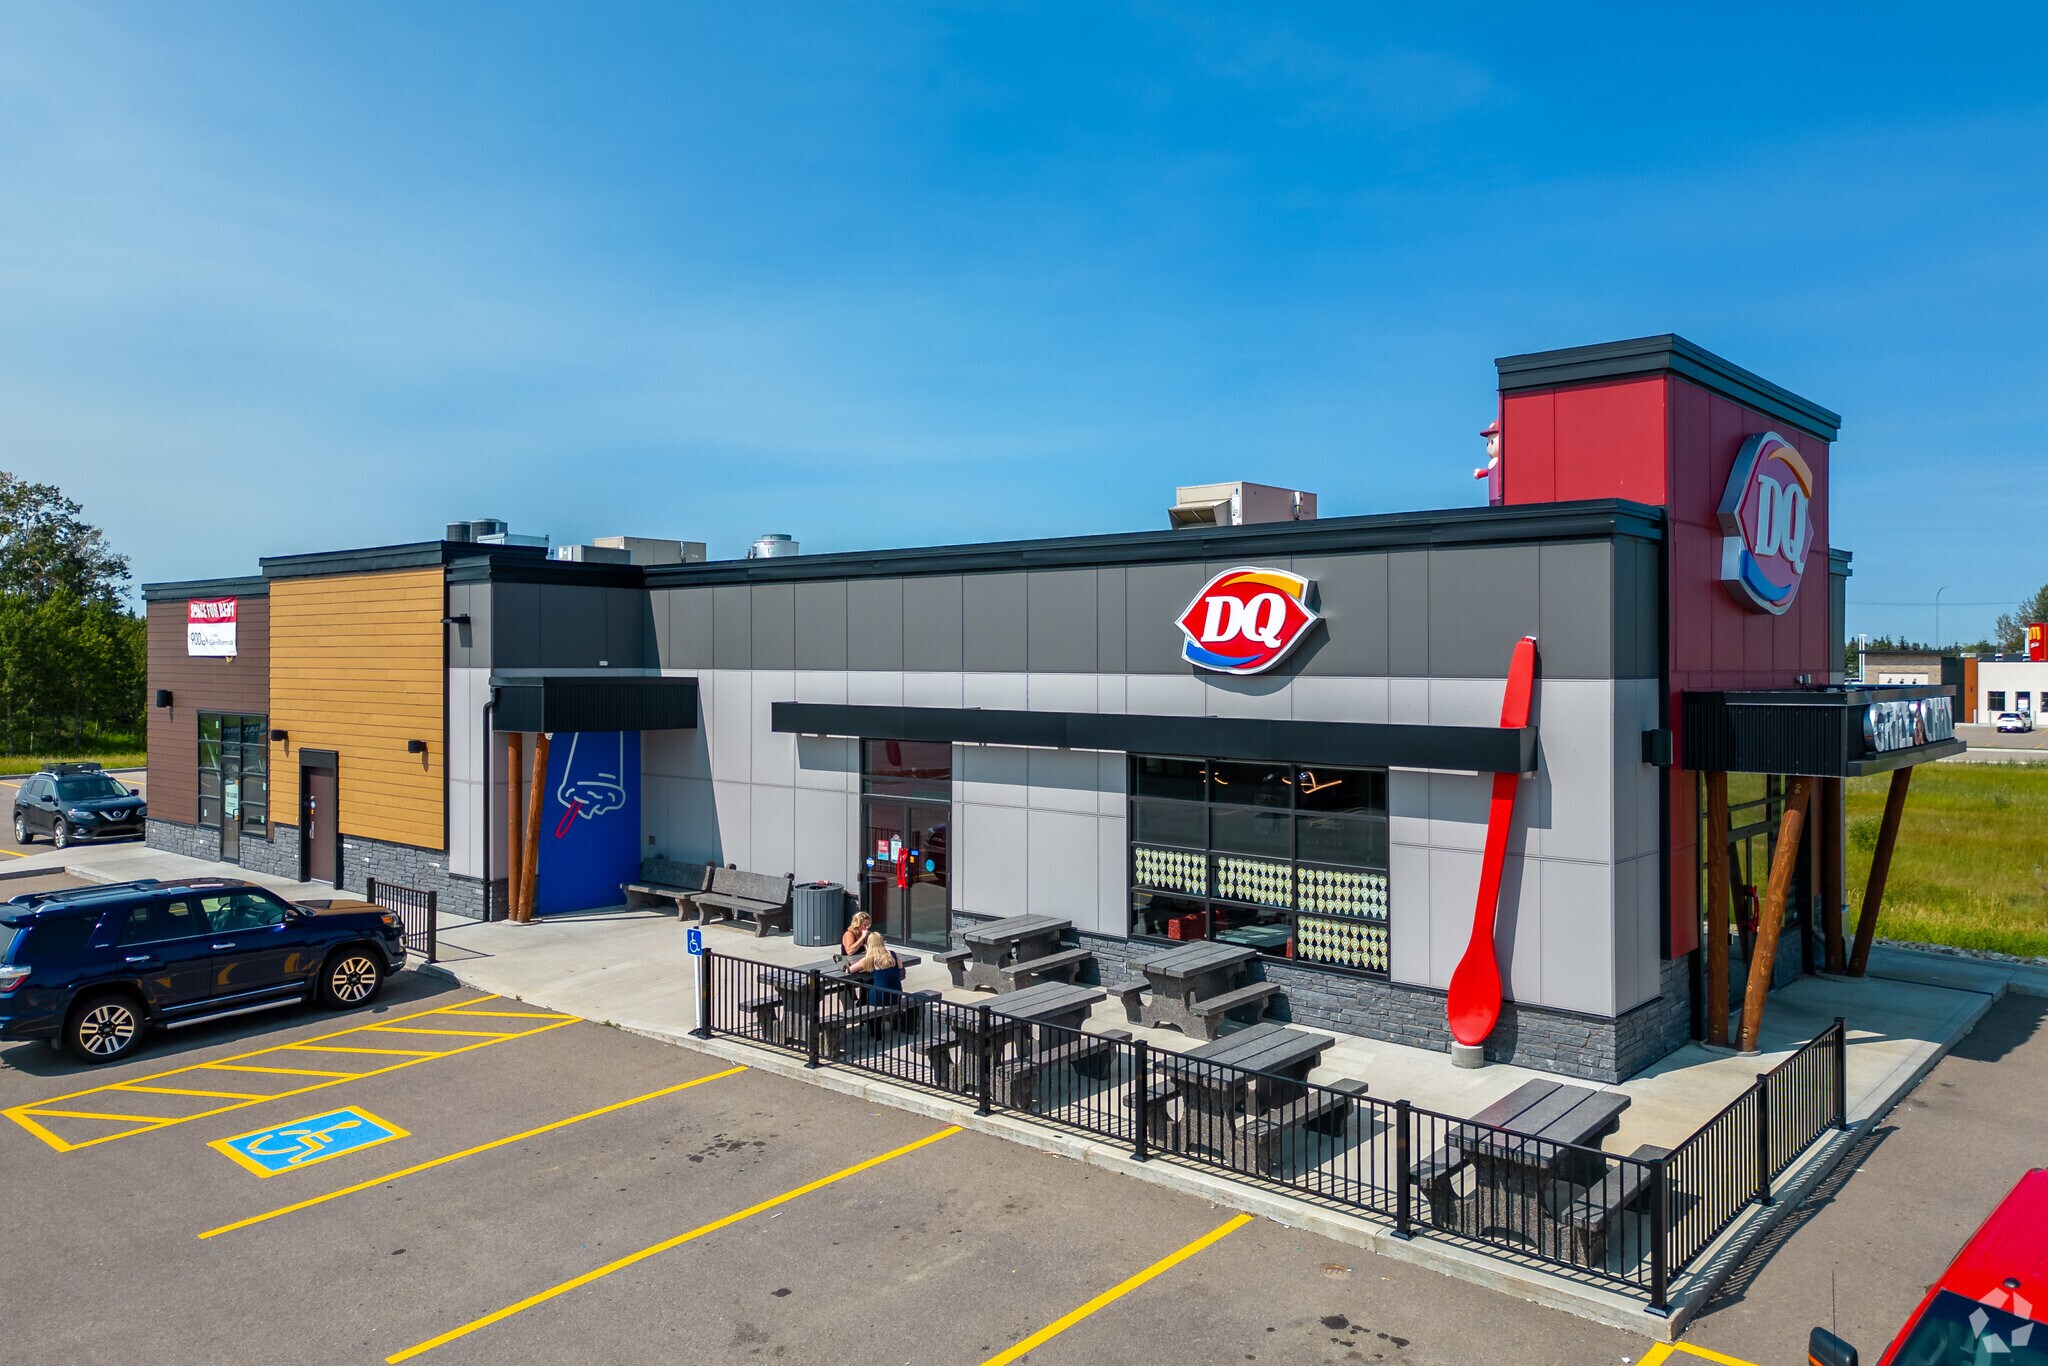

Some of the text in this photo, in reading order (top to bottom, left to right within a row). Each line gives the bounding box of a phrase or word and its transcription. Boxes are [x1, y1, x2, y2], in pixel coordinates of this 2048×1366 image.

[1755, 474, 1806, 574] DQ
[207, 602, 220, 618] FOR
[219, 601, 234, 617] RENT
[1201, 592, 1282, 648] DQ
